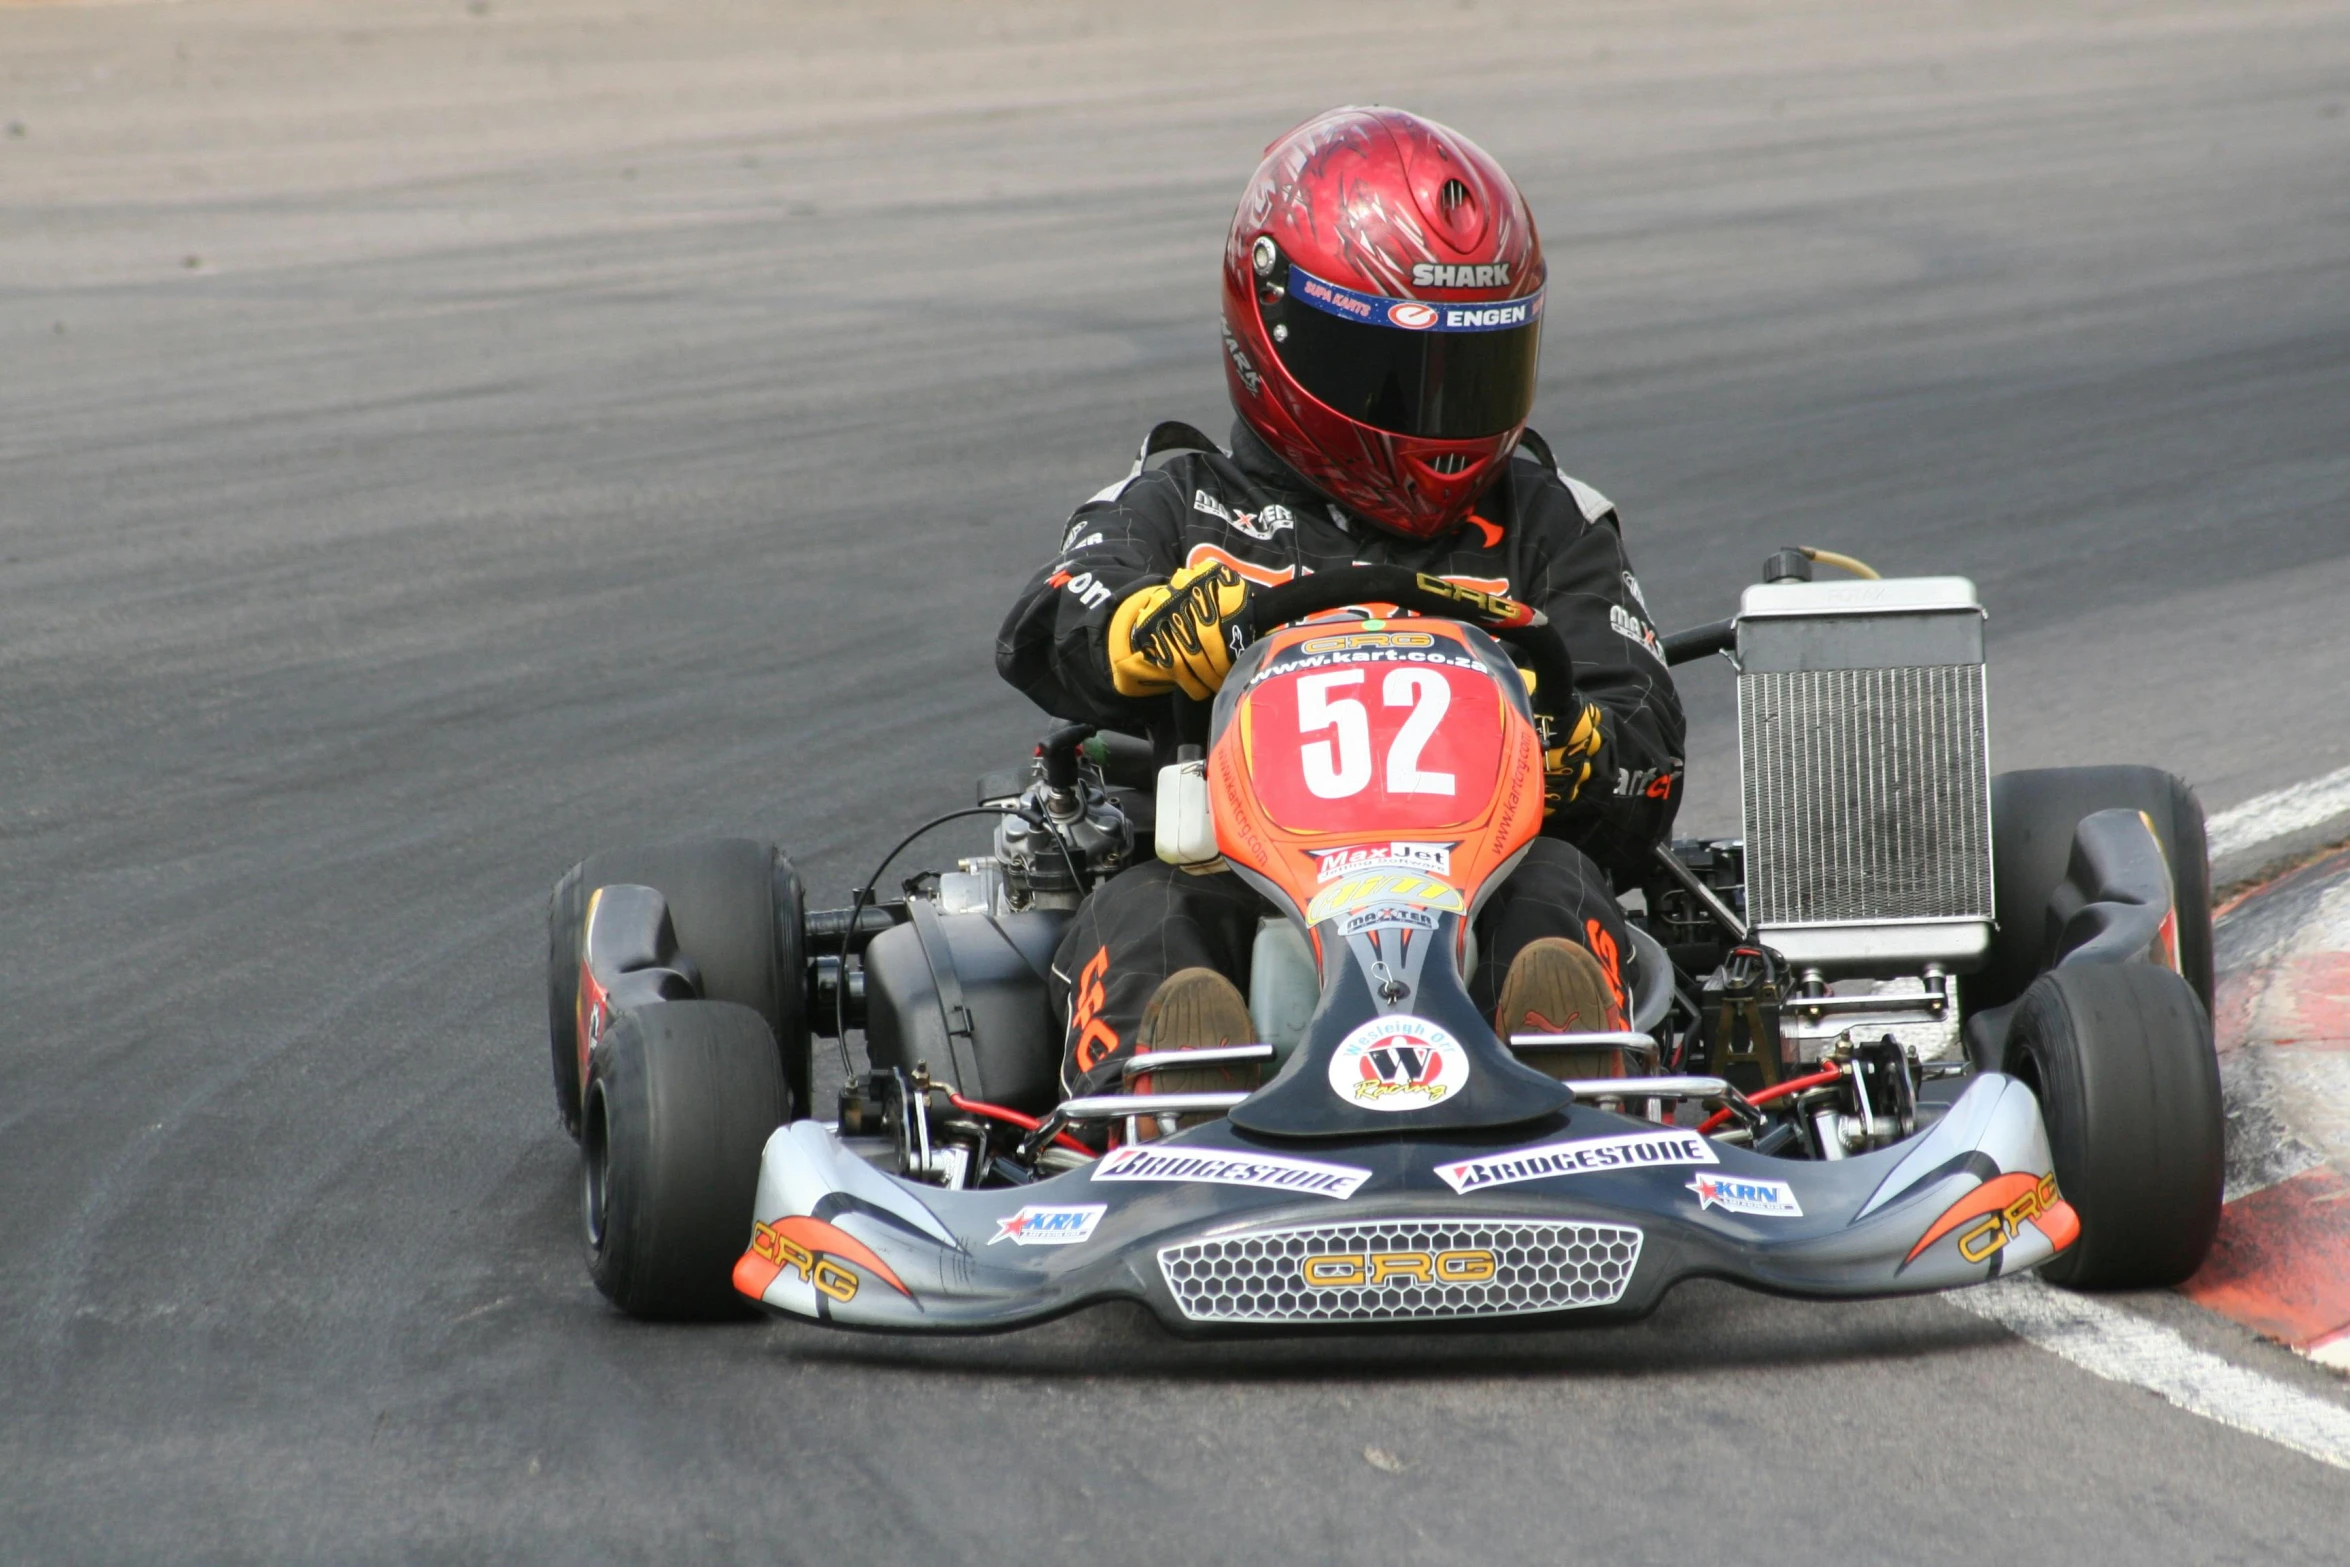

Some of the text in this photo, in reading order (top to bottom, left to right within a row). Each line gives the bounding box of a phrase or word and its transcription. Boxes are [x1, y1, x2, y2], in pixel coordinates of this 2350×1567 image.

[1413, 263, 1511, 288] SHARK
[1304, 281, 1372, 317] SUPA KARTS
[1447, 305, 1526, 327] ENGEN
[1417, 571, 1522, 619] CRG
[1302, 633, 1434, 654] CRG
[1250, 648, 1489, 685] www.kart.co.za
[1296, 667, 1455, 799] 52
[1492, 731, 1532, 855] www.kartcrg.com
[1343, 1020, 1456, 1057] Wesleigh Orr
[1353, 1078, 1448, 1101] Racing
[1100, 1150, 1359, 1192] BRIDGESTONE
[1459, 1138, 1705, 1189] BRIDGESTONE
[1715, 1181, 1778, 1203] KRN
[1022, 1212, 1096, 1230] KRN
[1958, 1170, 2060, 1263] CRG
[752, 1220, 859, 1304] CRG
[1302, 1249, 1498, 1288] CRG
